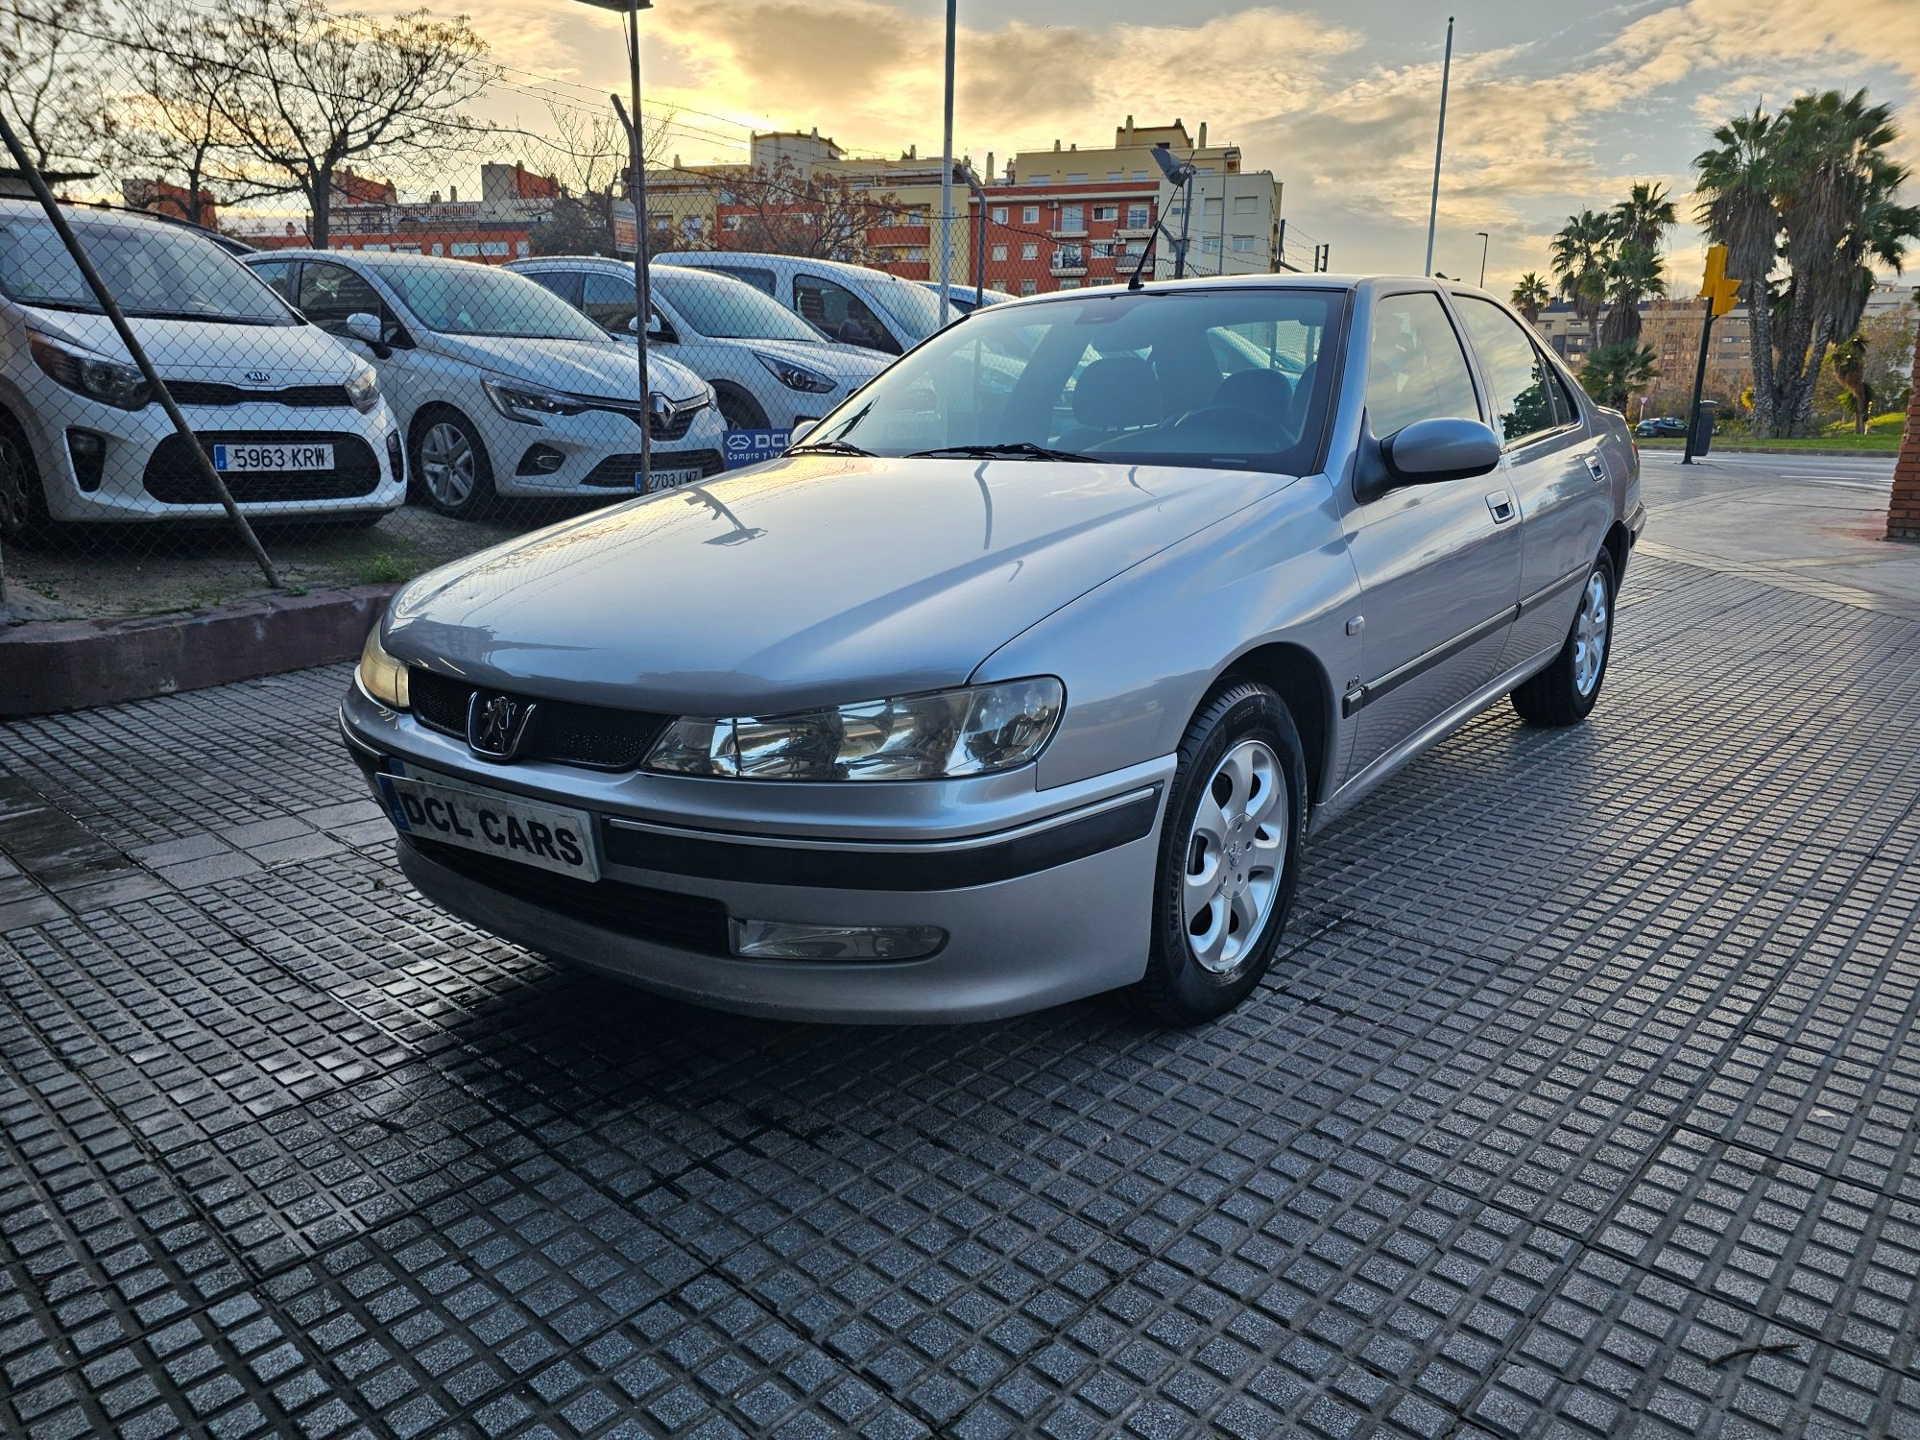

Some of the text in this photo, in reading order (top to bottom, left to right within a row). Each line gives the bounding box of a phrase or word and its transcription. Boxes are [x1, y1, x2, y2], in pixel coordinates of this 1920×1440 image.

[249, 371, 270, 382] KIA
[234, 448, 285, 468] 5963
[292, 448, 325, 467] KRW
[648, 473, 677, 491] 2703
[399, 792, 583, 866] DCL CARS
